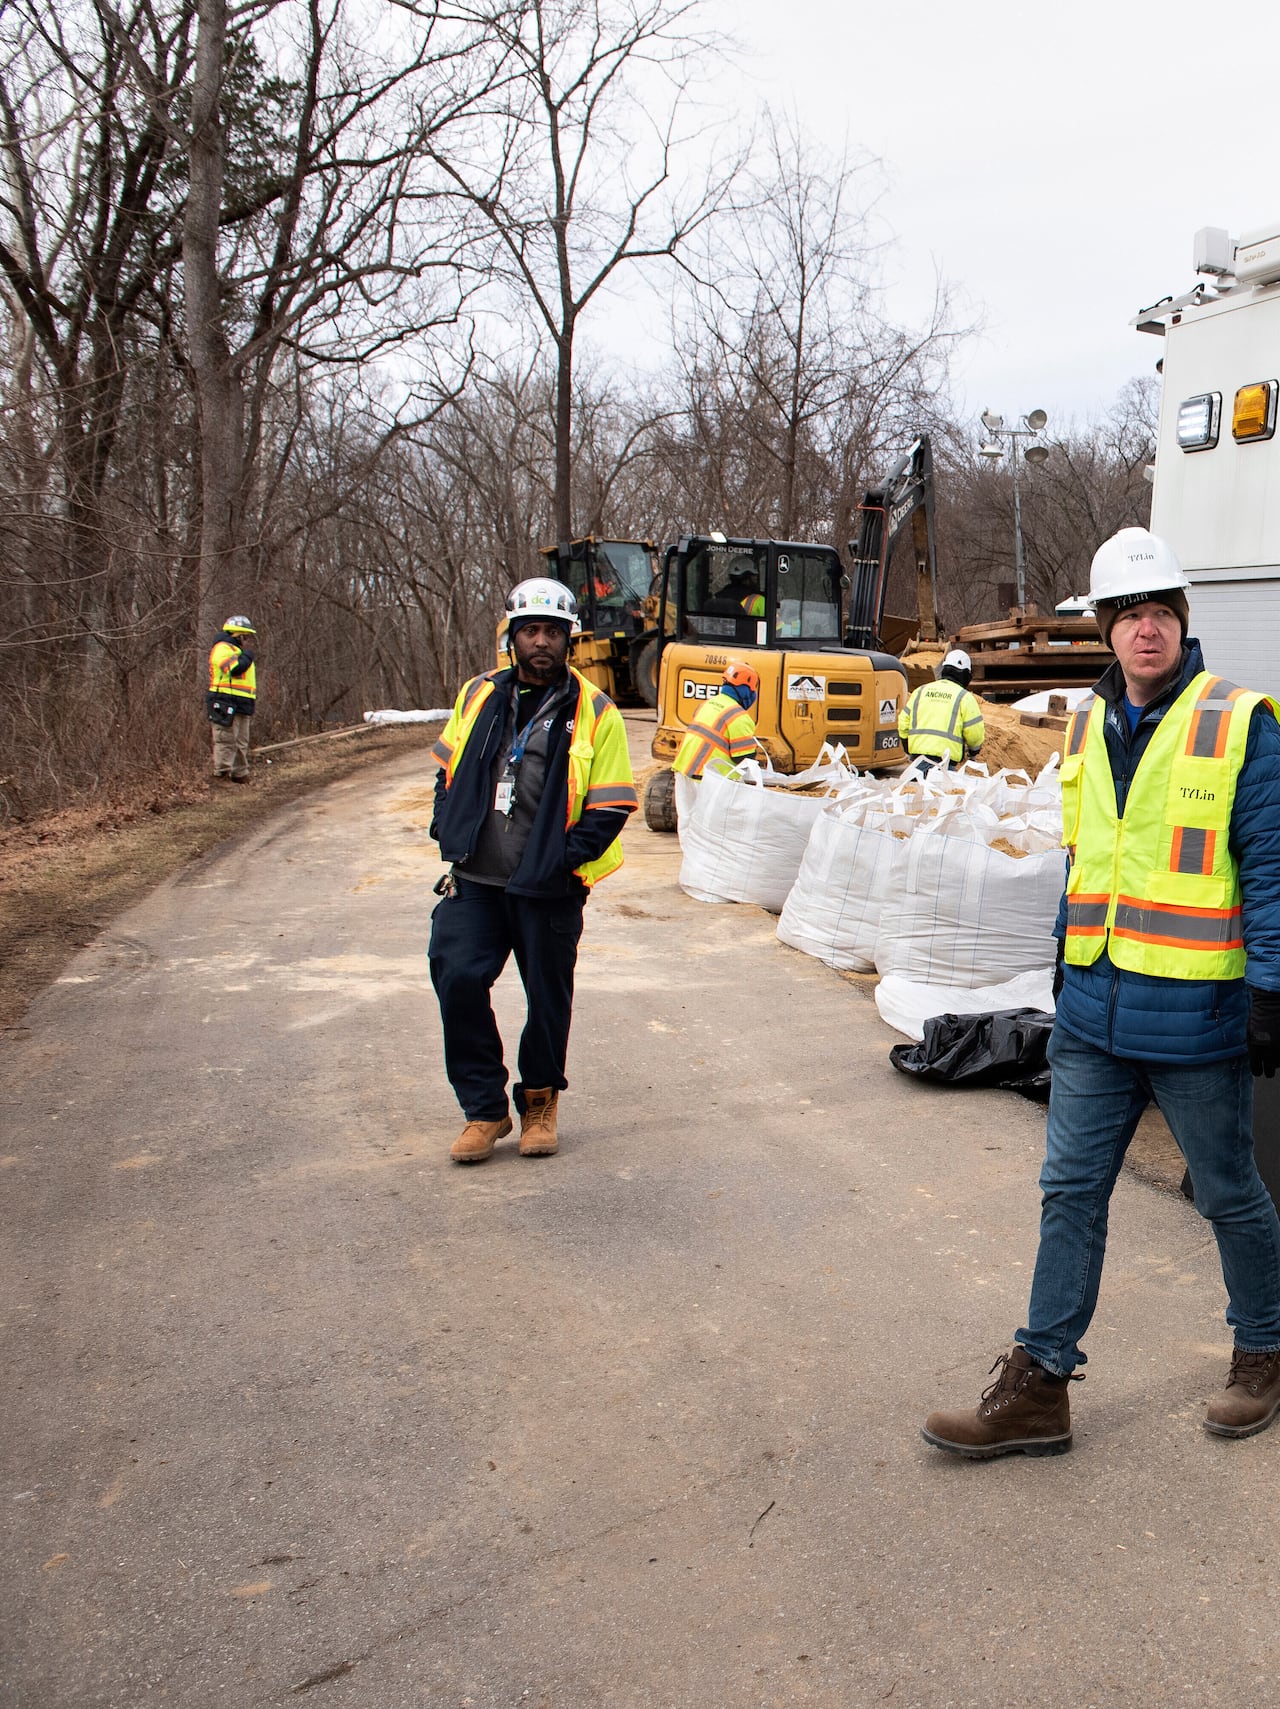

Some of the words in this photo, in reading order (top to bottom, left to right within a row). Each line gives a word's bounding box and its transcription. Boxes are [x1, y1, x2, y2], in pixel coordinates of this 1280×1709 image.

[706, 544, 727, 553] JOHN
[728, 546, 754, 555] DEERE
[1128, 553, 1154, 562] TYLin
[683, 679, 723, 701] DEE
[1180, 787, 1215, 801] TYLin
